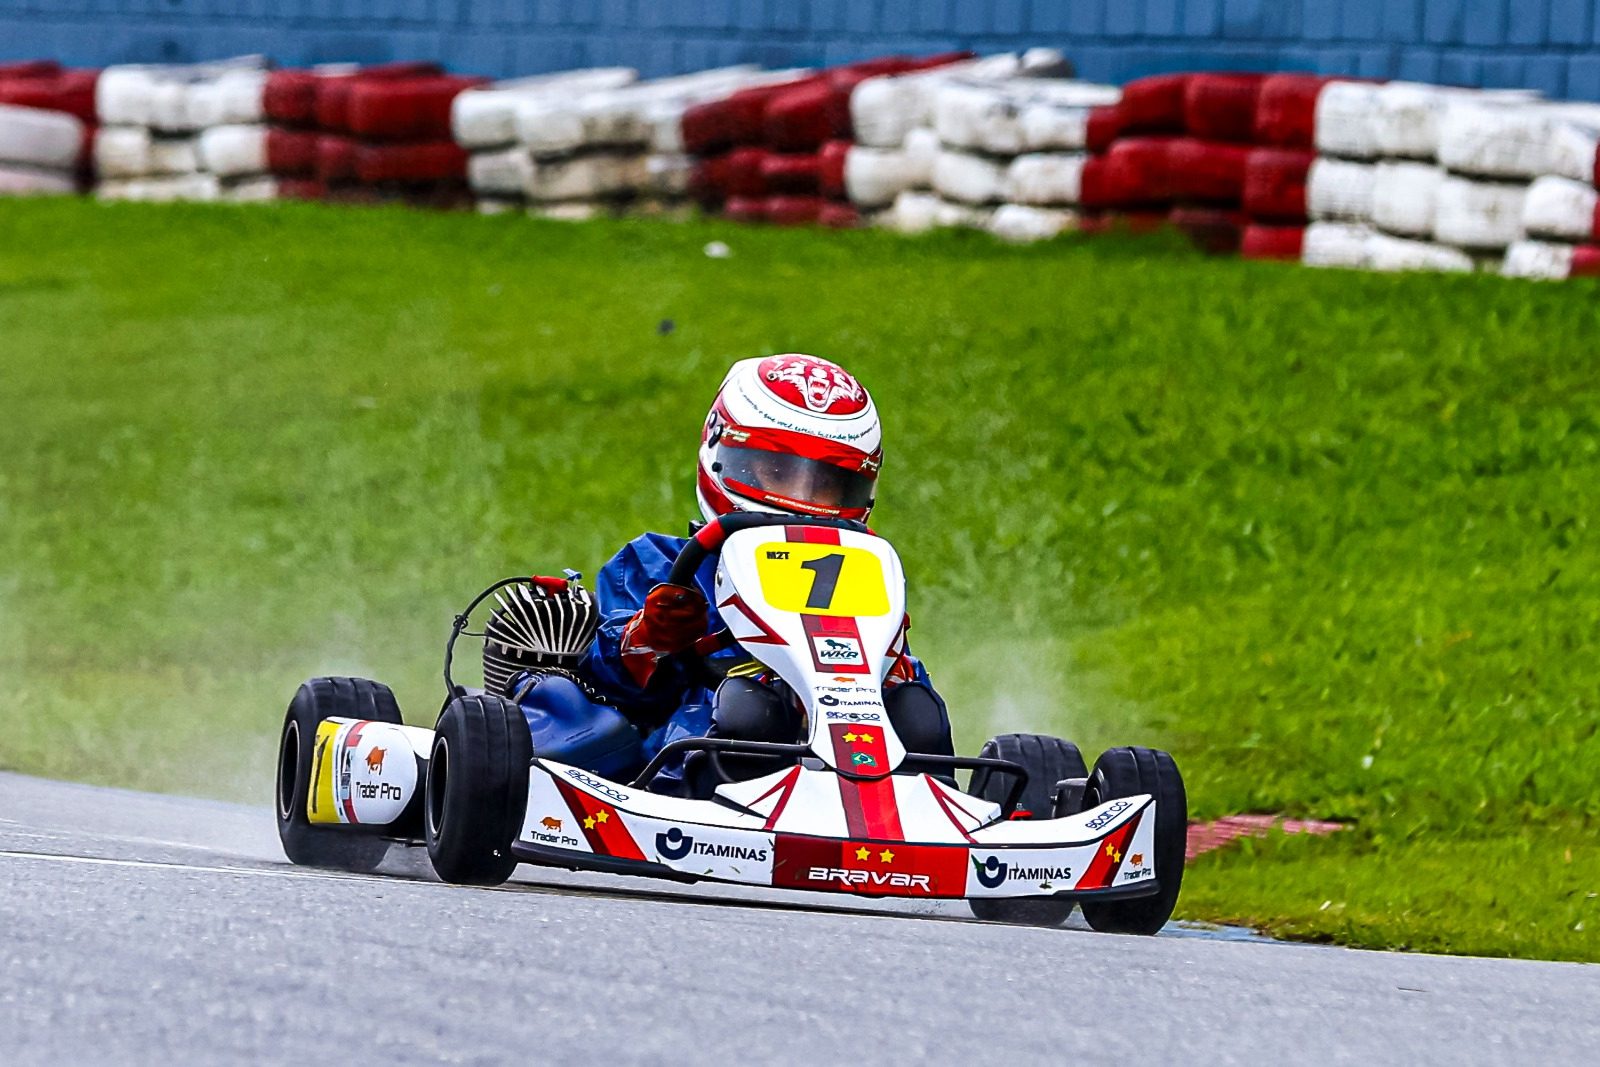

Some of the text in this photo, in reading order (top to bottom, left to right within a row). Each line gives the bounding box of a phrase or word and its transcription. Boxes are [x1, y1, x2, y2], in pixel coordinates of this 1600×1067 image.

[766, 551, 790, 560] M2T
[801, 553, 846, 609] 1
[820, 650, 859, 658] WKR
[356, 781, 401, 800] Trader Pro
[564, 768, 630, 802] sparco
[1085, 801, 1133, 830] sparco
[531, 830, 578, 846] Trader Pro
[693, 842, 767, 862] ITAMINAS
[1008, 866, 1072, 881] ITAMINAS
